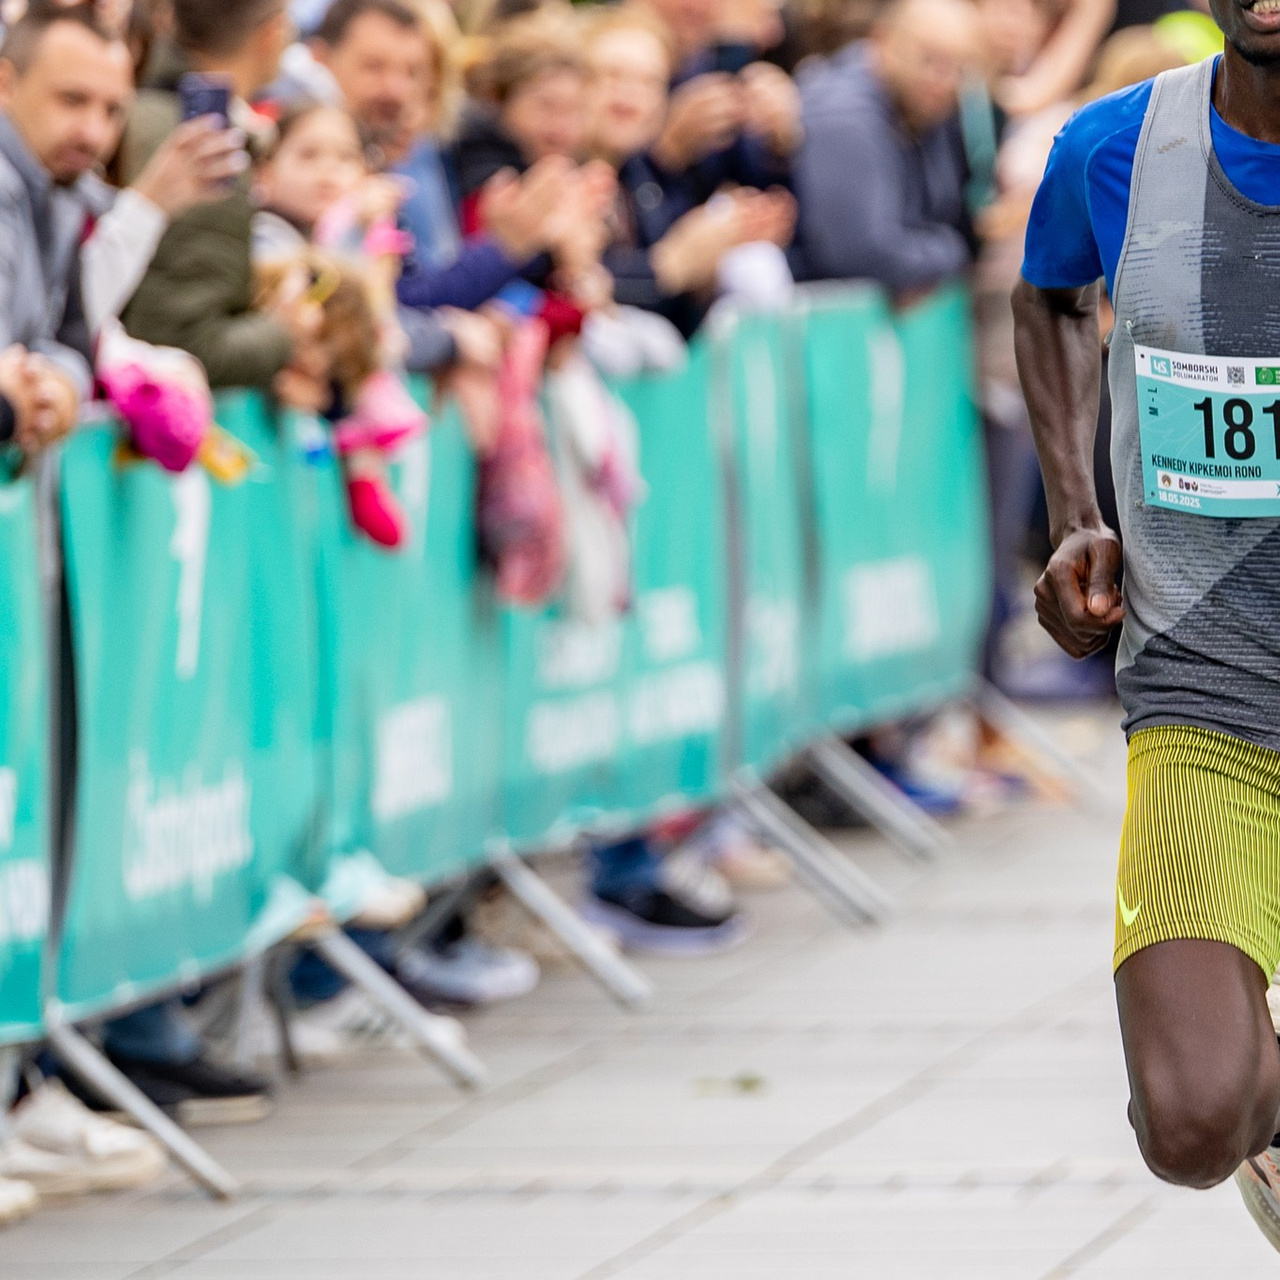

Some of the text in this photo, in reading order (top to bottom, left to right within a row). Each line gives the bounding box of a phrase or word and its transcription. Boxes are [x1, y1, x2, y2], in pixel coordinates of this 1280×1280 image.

[1172, 361, 1218, 374] SOMBORSKI
[1173, 370, 1219, 382] POLUMARATON
[1149, 406, 1159, 417] M
[1152, 454, 1262, 478] KENNEDY KIPKEMOI RONO
